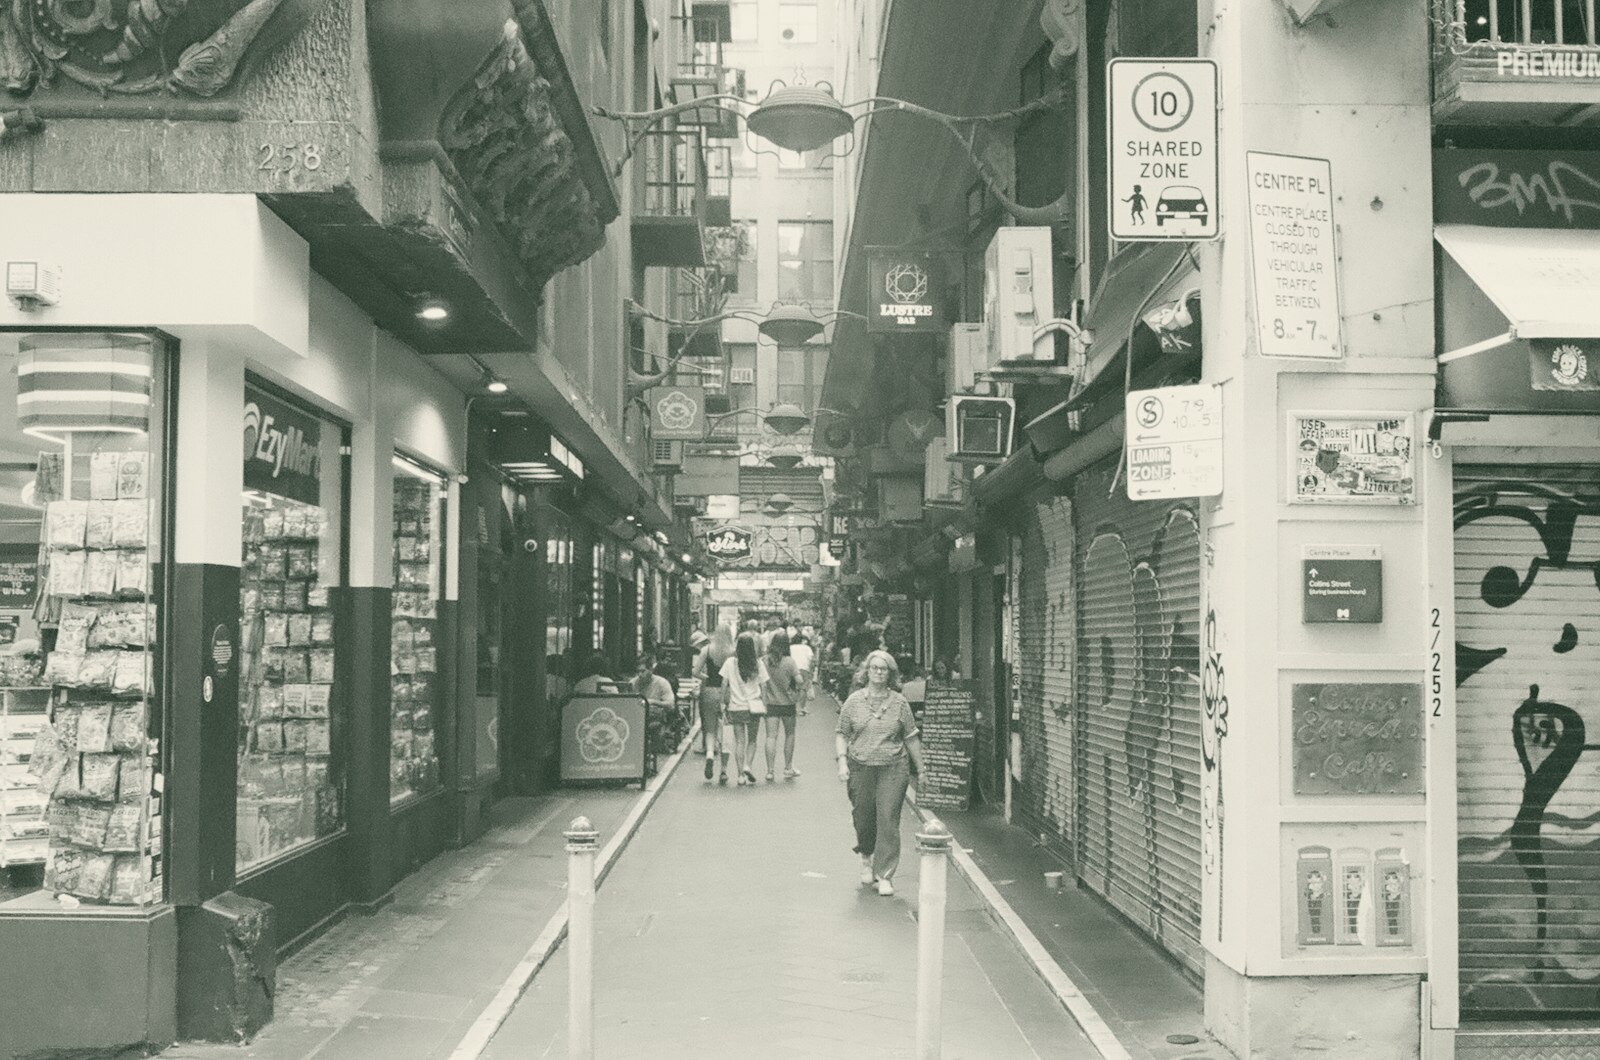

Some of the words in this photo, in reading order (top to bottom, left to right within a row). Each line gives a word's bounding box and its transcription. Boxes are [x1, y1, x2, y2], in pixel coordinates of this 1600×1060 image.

[1151, 91, 1178, 117] 10
[257, 143, 321, 171] 258
[1126, 140, 1203, 158] SHARED
[1139, 163, 1189, 179] ZONE
[1254, 171, 1304, 192] CENTRE
[1307, 177, 1326, 194] PL
[1254, 203, 1293, 219] CENTRE
[1295, 207, 1328, 222] PLACE
[1265, 222, 1304, 237] CLOSED
[1306, 226, 1320, 238] TO
[1269, 240, 1318, 255] THROUGH
[1266, 258, 1323, 274] VEHICULAR
[1275, 277, 1317, 292] TRAFFIC
[1275, 294, 1320, 309] BETWEEN
[880, 304, 932, 316] LUSTRE
[896, 316, 915, 325] BAR
[1132, 447, 1170, 463] LOADING
[1131, 464, 1170, 480] ZONE
[1309, 580, 1330, 588] Collins
[1331, 580, 1351, 588] Street
